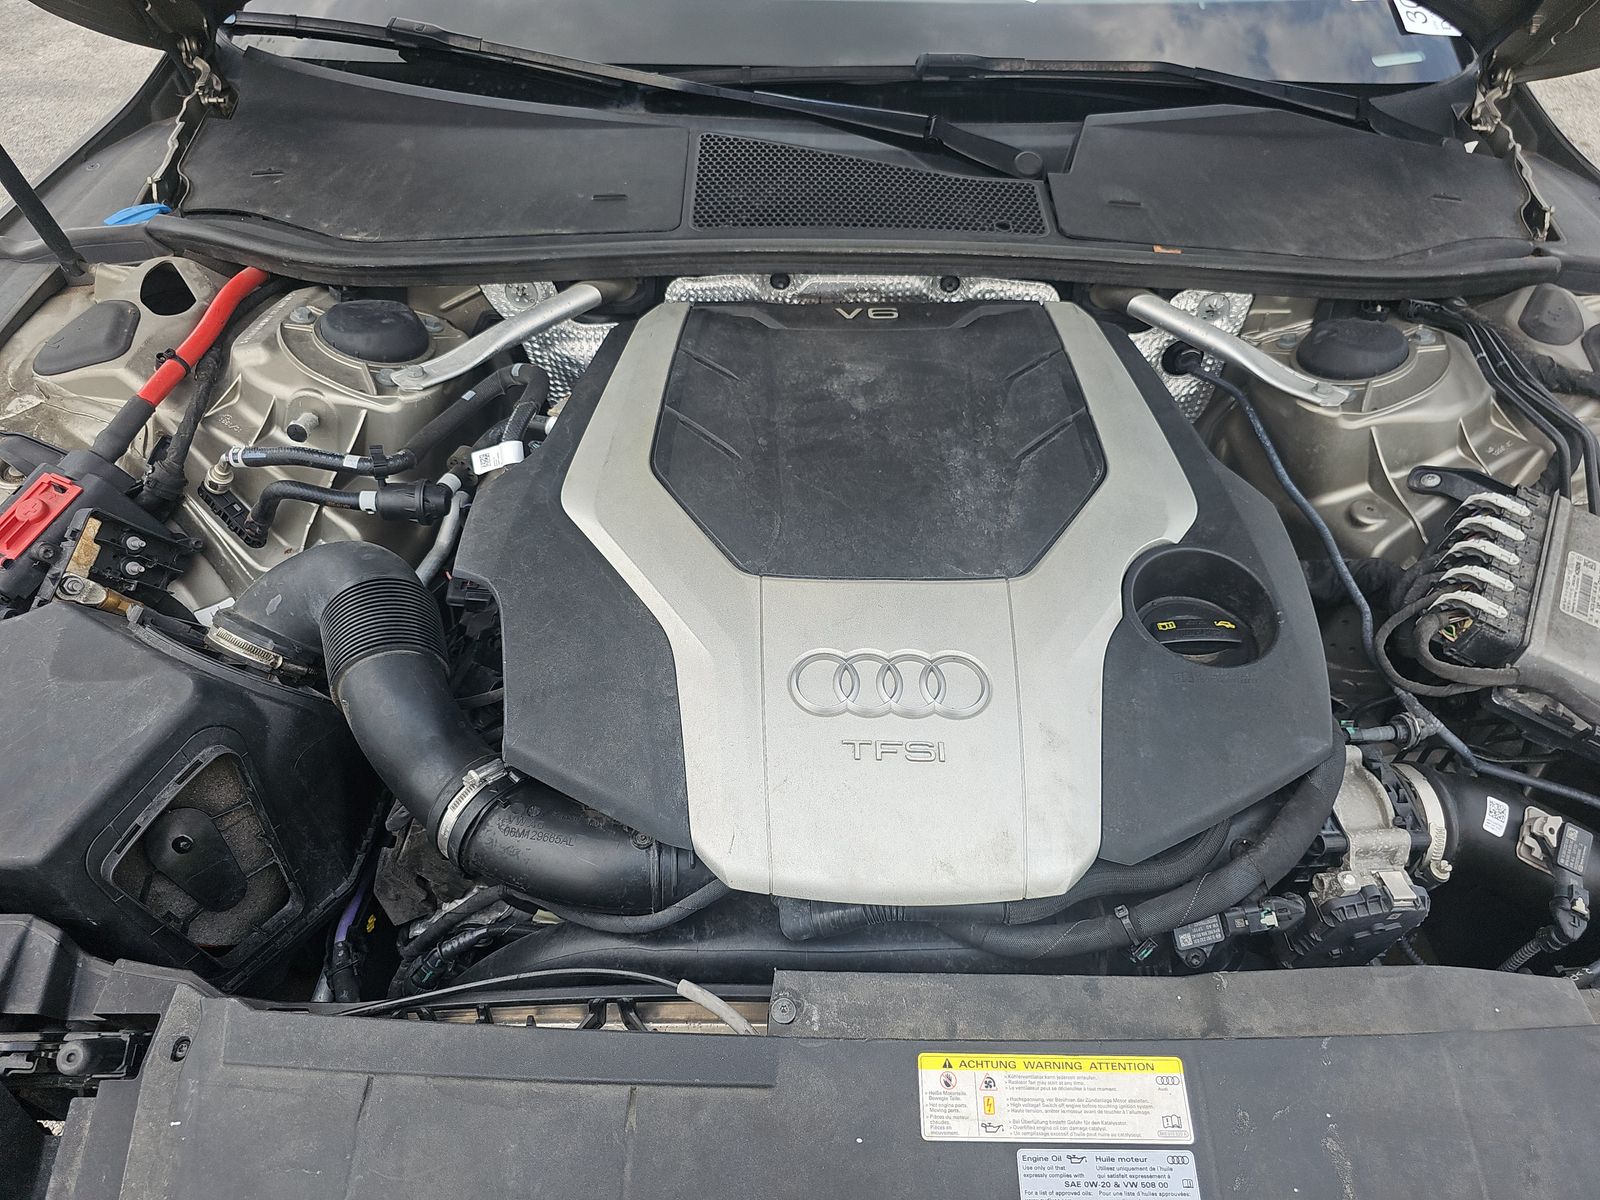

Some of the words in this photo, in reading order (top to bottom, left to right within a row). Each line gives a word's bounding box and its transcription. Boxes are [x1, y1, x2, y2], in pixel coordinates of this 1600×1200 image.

[834, 307, 899, 319] V6
[841, 739, 946, 763] TFSI
[959, 1060, 1017, 1070] ACHTUNG
[1023, 1061, 1082, 1071] WARNING
[1089, 1062, 1155, 1071] ATTENTION
[1022, 1155, 1049, 1163] Engine
